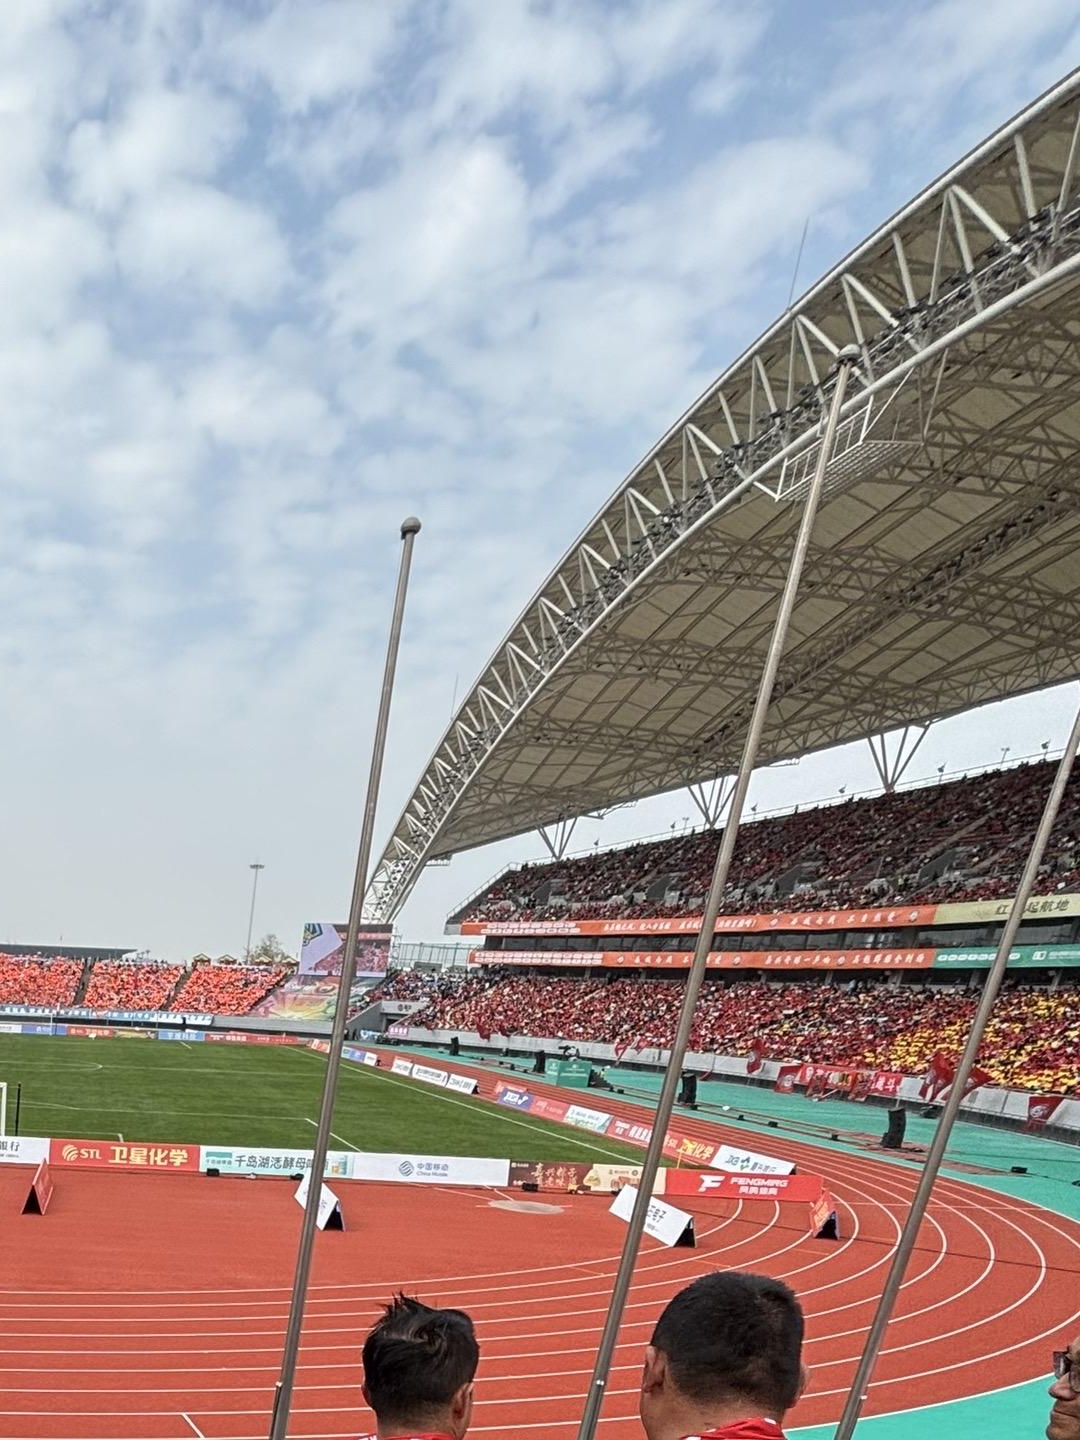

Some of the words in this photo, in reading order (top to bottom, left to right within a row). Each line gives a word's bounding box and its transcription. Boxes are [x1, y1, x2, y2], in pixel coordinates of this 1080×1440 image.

[995, 900, 1070, 915] 红起航地
[108, 1145, 188, 1166] 卫星化学
[417, 1162, 449, 1171] 中国移动
